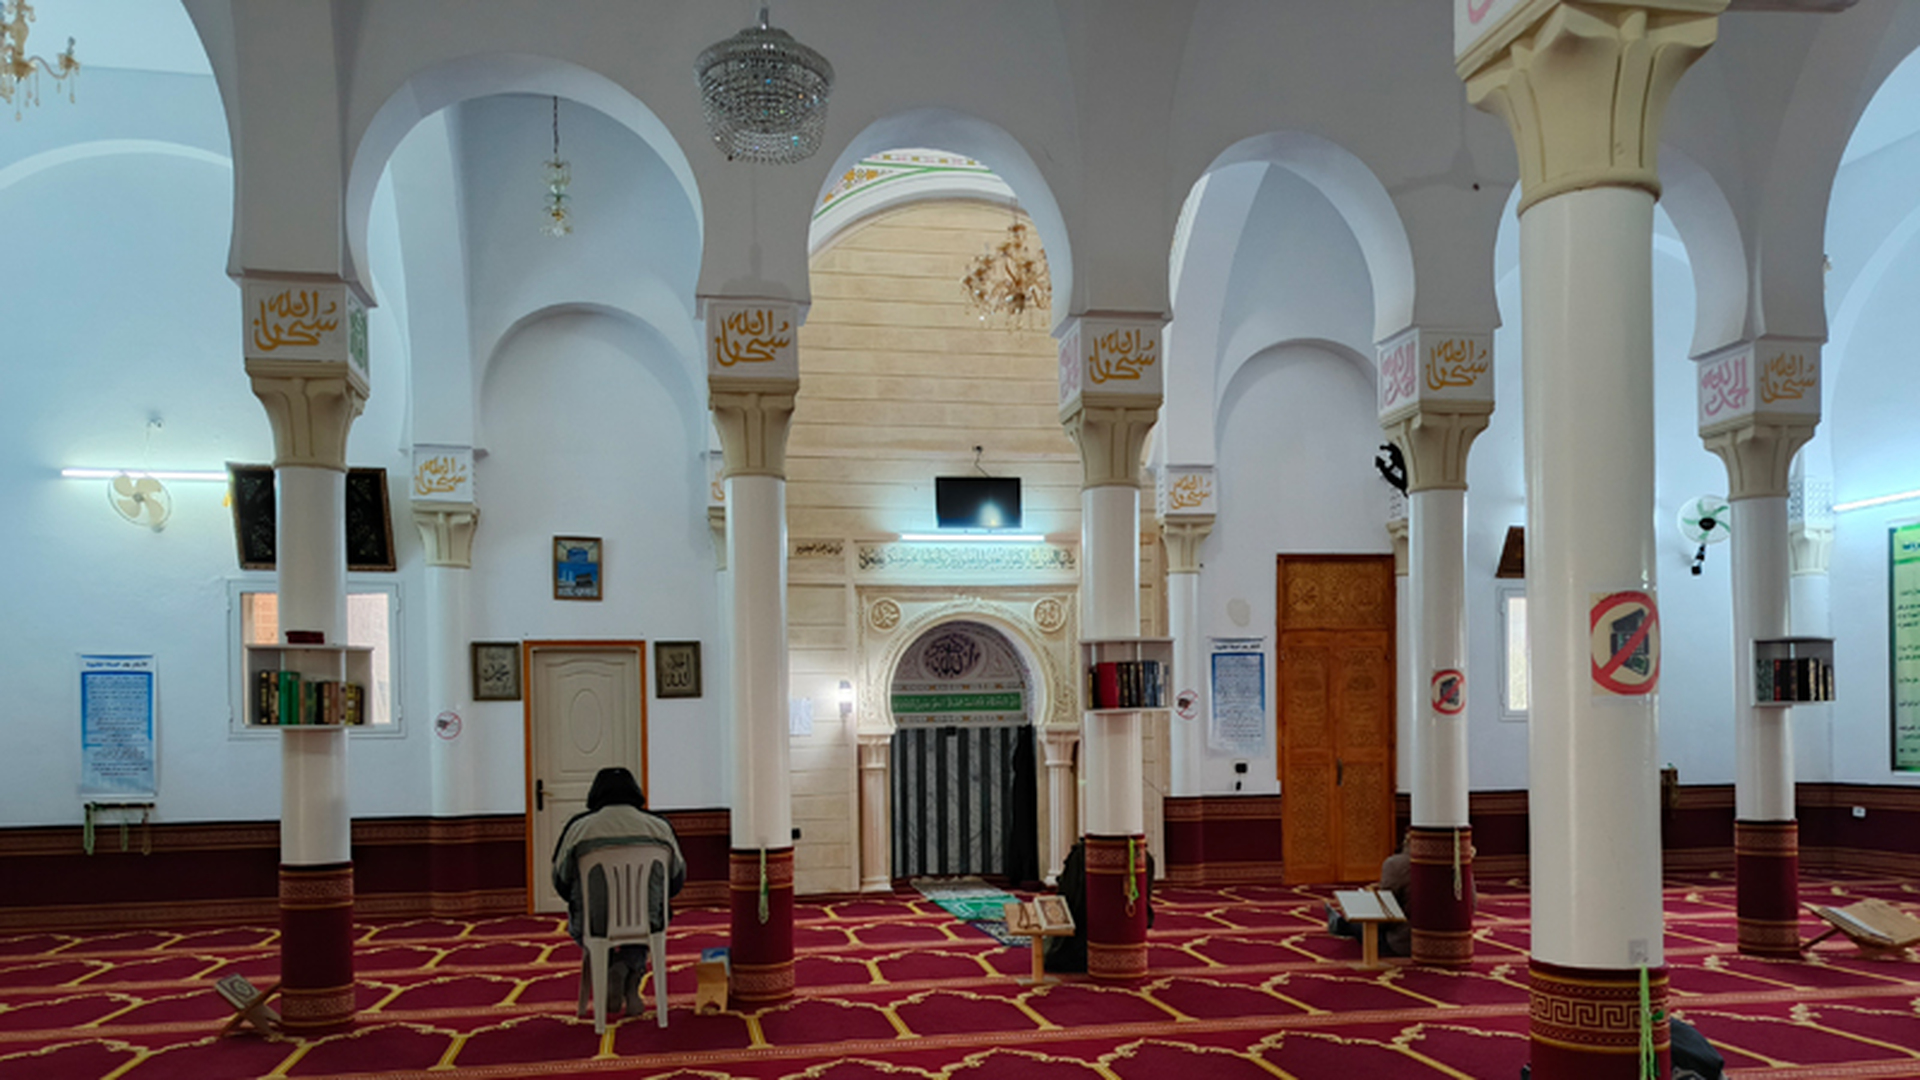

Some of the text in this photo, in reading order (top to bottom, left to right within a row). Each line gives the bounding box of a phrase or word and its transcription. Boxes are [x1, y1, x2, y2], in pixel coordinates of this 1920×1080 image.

[268, 288, 319, 320] الله
[727, 309, 773, 336] الله
[1101, 328, 1141, 355] الله
[1437, 339, 1474, 363] الله
[1771, 352, 1803, 377] الله
